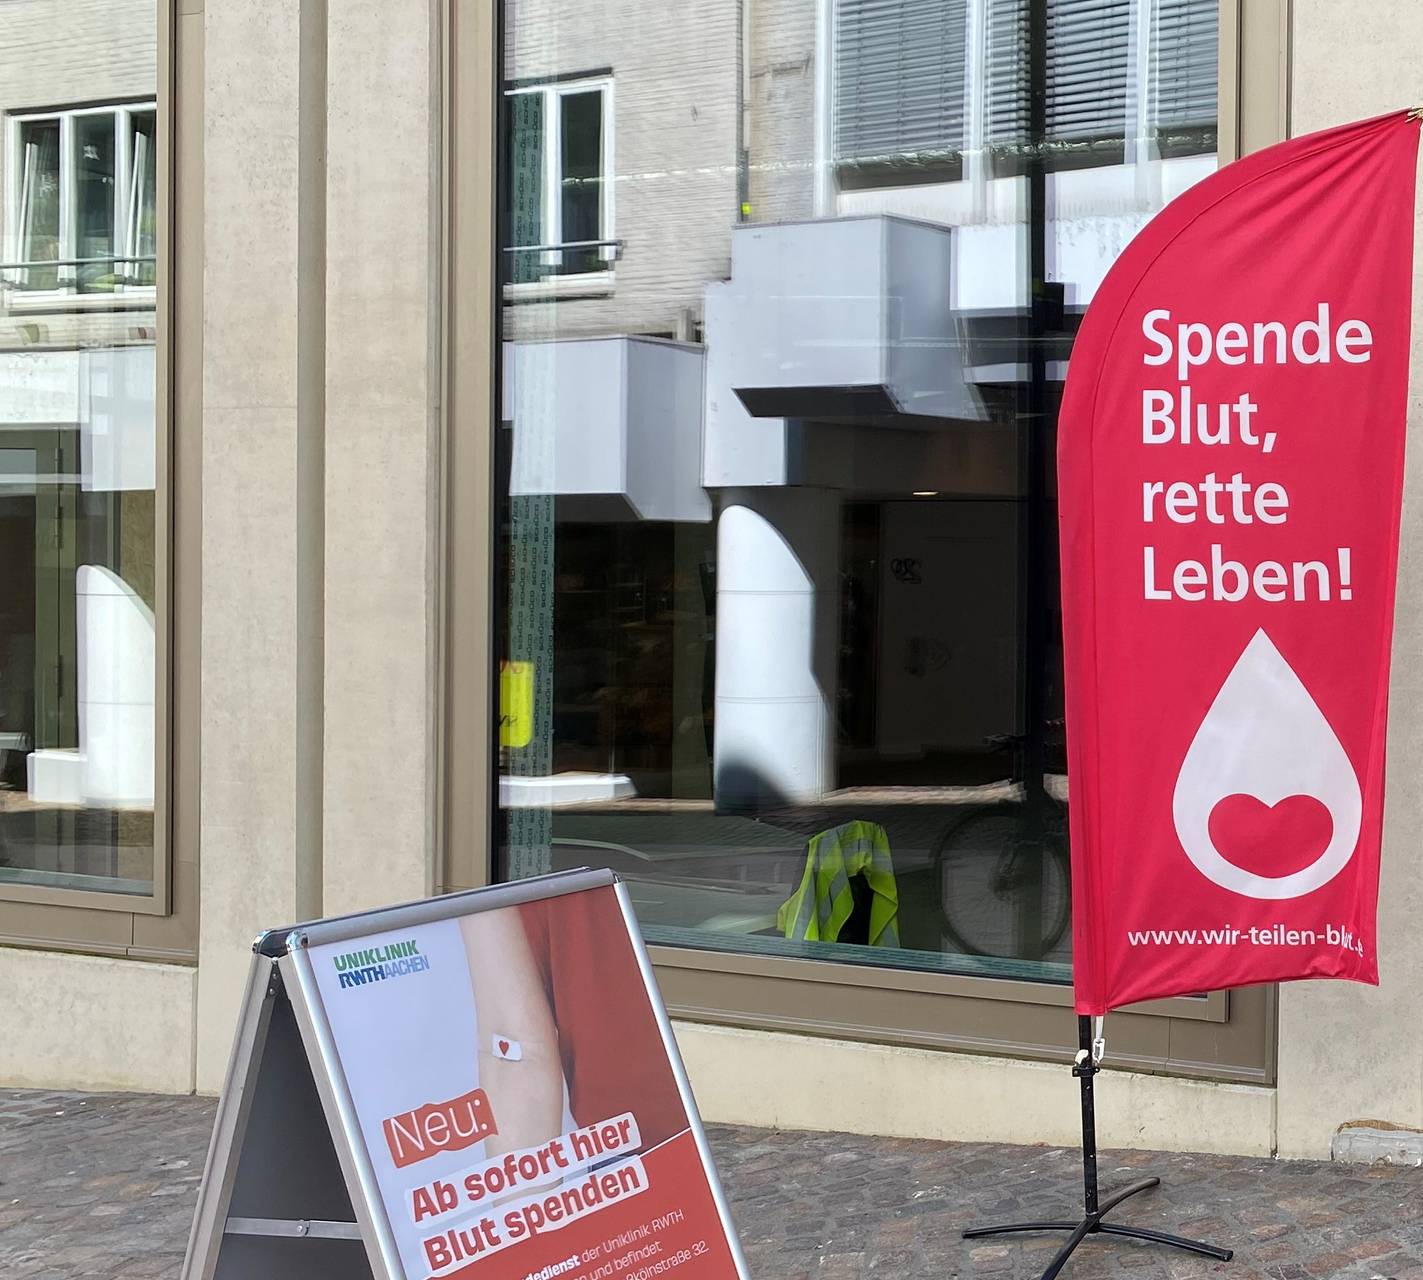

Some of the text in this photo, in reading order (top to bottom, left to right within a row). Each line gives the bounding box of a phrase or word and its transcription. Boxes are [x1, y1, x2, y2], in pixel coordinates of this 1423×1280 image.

[1142, 302, 1373, 381] Spende
[1142, 386, 1277, 453] Blut,
[1142, 472, 1289, 524] rette
[1143, 544, 1353, 601] Leben!
[333, 940, 419, 971] UNIKLINIK
[390, 1099, 488, 1158] Neu:
[413, 1118, 630, 1222] Ab sofort hier
[424, 1164, 641, 1271] Blut spenden
[582, 1245, 601, 1263] der
[603, 1223, 651, 1253] Uniklinik
[652, 1208, 685, 1233] RWTH
[590, 1240, 663, 1280] und befindet
